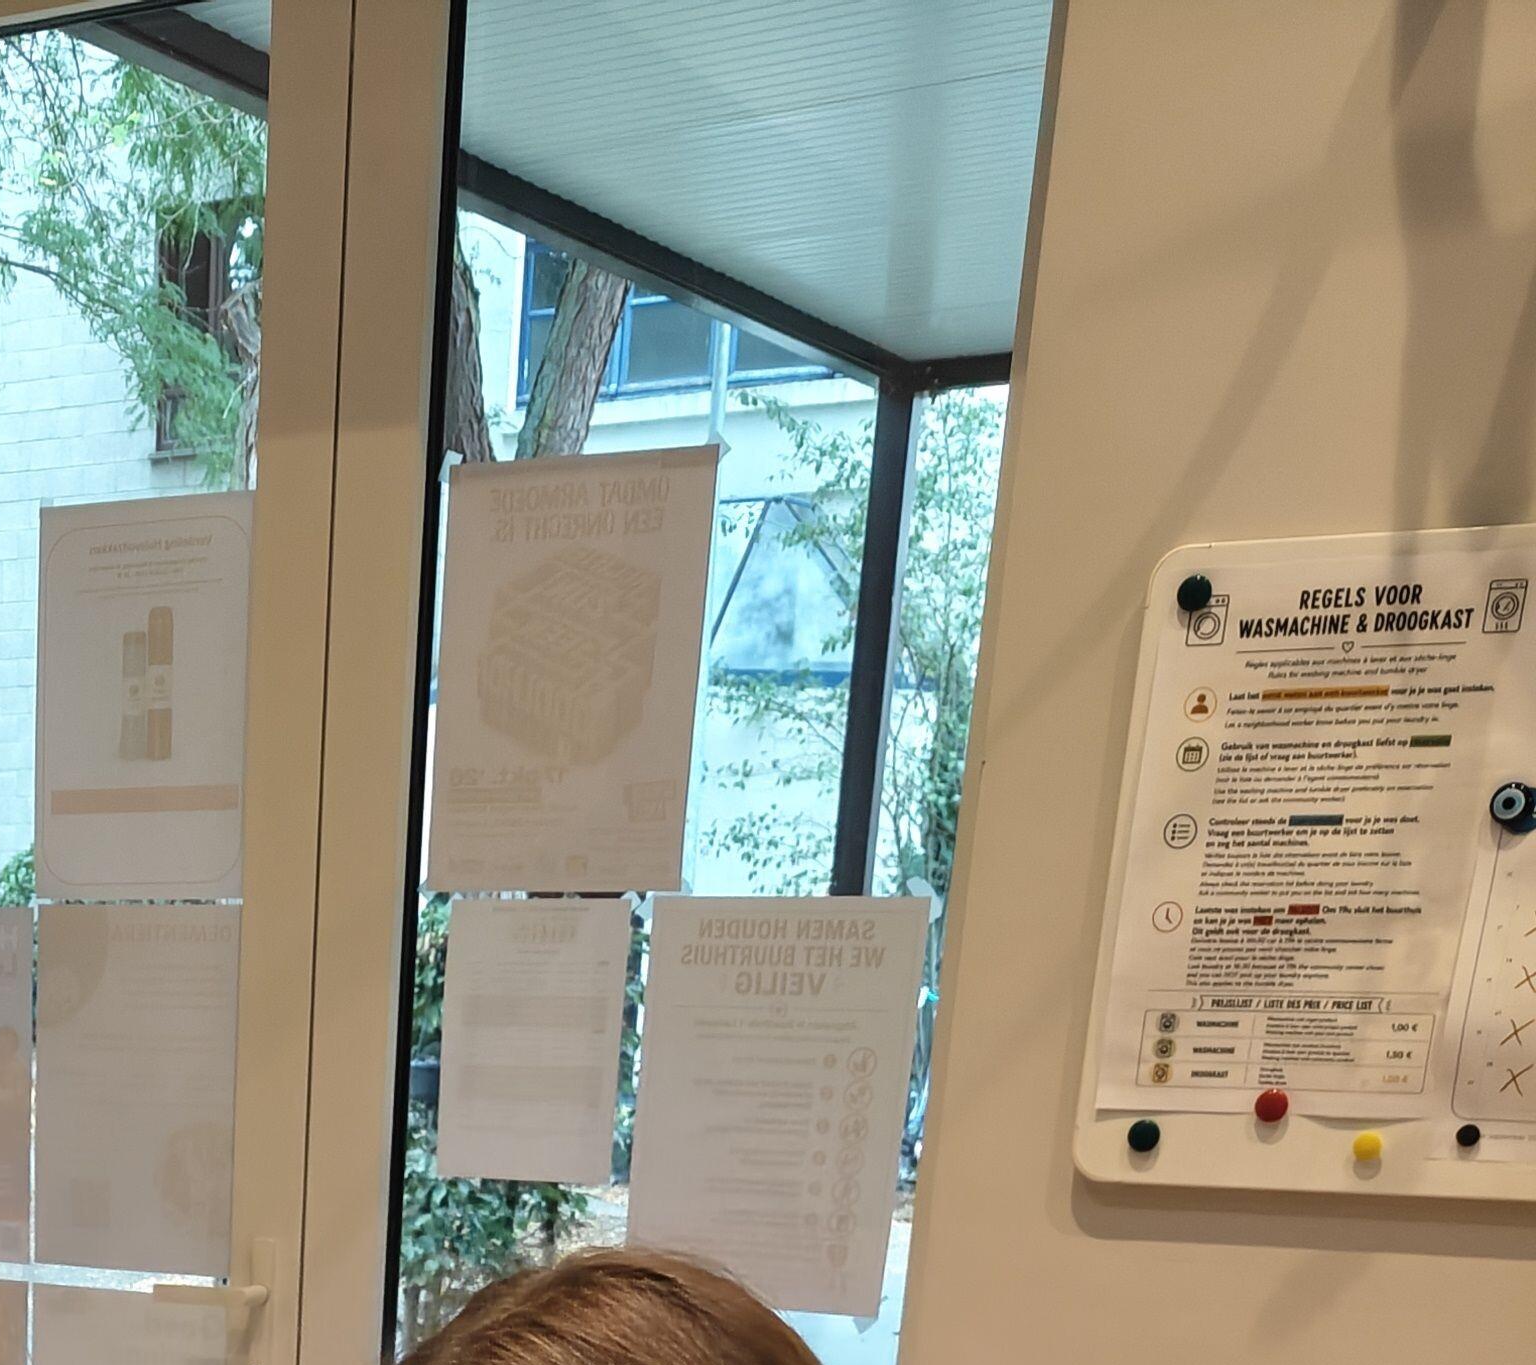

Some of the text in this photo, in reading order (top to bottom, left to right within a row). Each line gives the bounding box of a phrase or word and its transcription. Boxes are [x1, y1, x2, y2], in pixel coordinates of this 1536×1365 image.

[1299, 584, 1423, 610] REGELS VOOR
[1239, 608, 1474, 639] WASMACHINE & DROOGKAST
